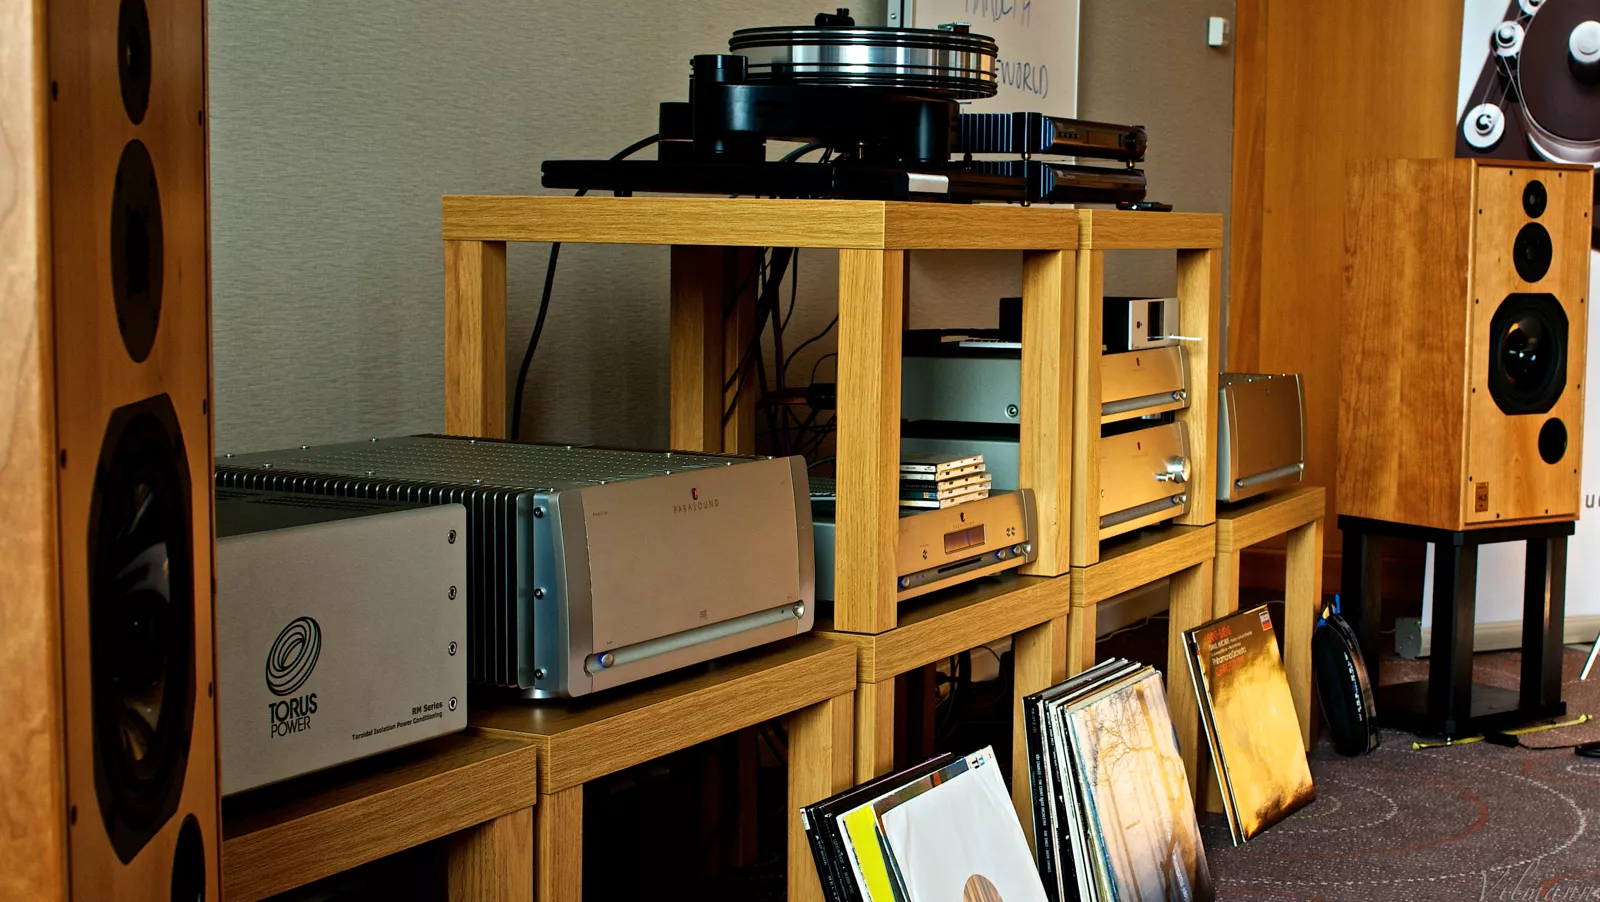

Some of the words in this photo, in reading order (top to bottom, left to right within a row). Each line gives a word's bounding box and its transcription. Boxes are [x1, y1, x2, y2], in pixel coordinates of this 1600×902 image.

[673, 499, 720, 514] PARASOUND
[268, 693, 318, 723] TORUS
[412, 706, 422, 715] RM
[423, 701, 443, 712] Series
[270, 716, 311, 738] POWER
[351, 729, 374, 740] Toroidal
[374, 723, 396, 735] Isolation
[396, 719, 413, 729] Power
[412, 711, 443, 724] Conditioning
